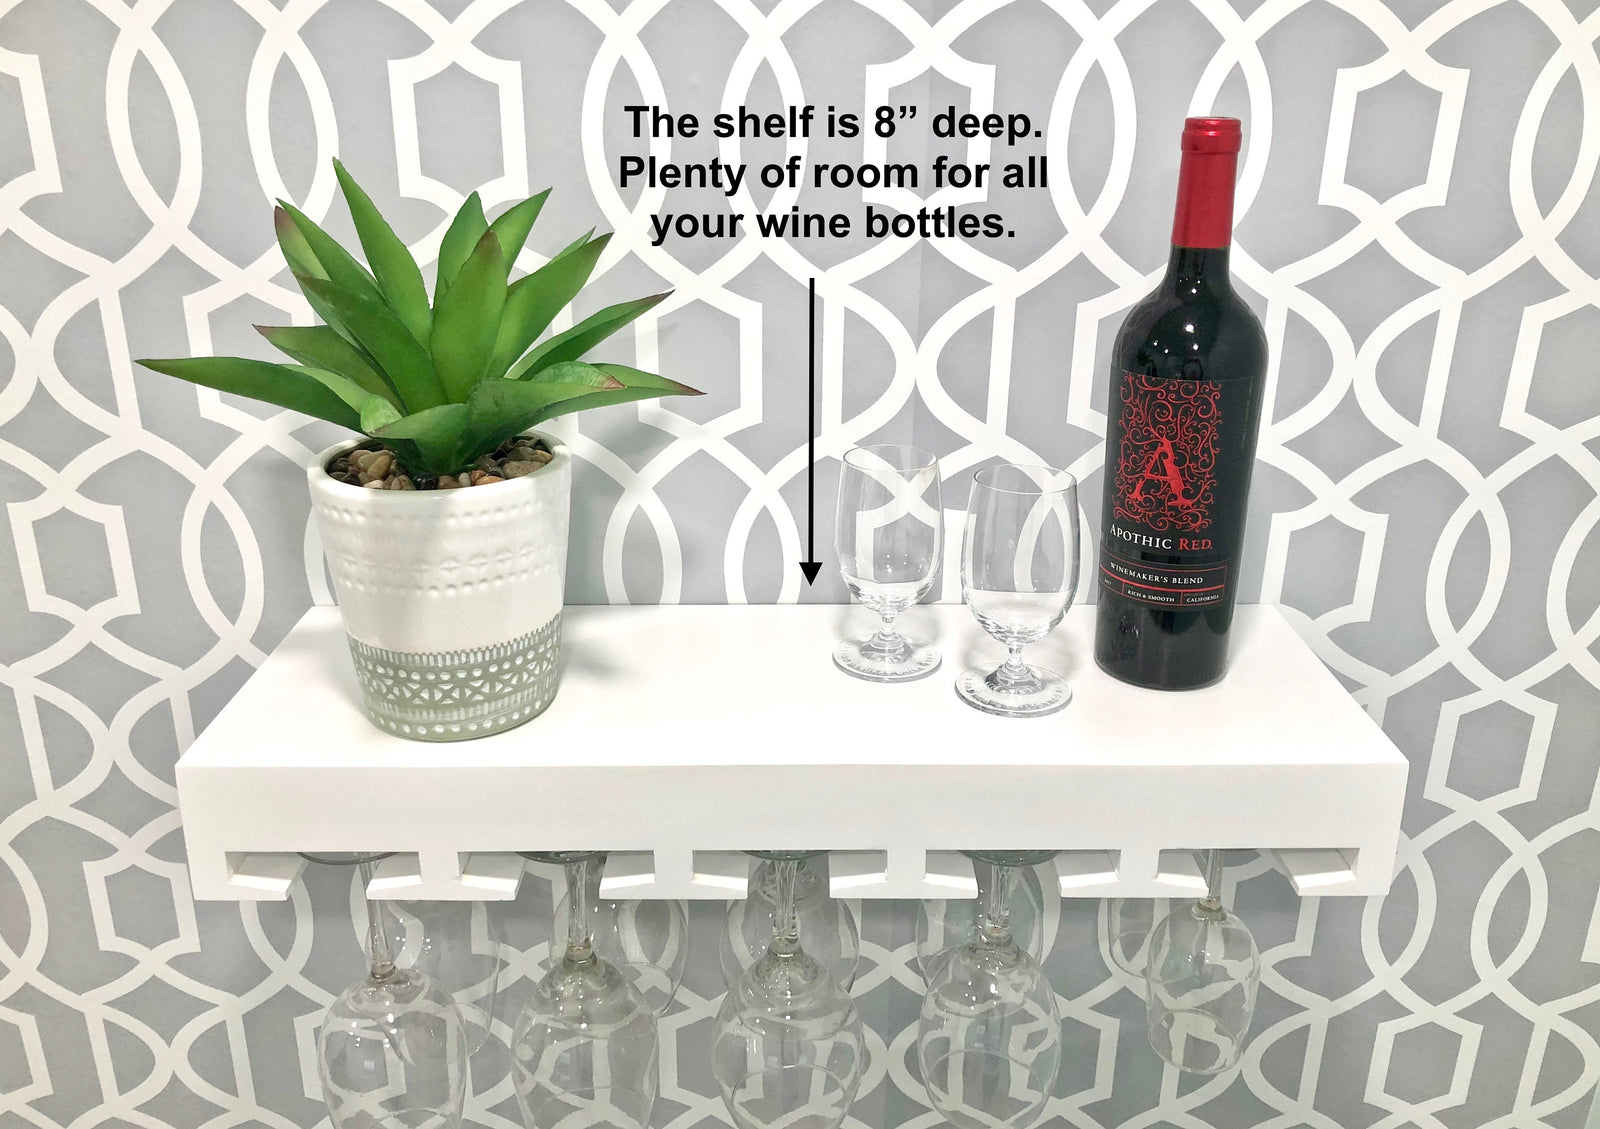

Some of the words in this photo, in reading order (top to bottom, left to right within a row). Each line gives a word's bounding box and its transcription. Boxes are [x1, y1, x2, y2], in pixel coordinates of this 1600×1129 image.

[1128, 435, 1194, 507] A
[1110, 523, 1172, 550] APOTHIC
[1110, 562, 1169, 583] WINEMAKER'S
[1172, 576, 1204, 585] BLEND
[1127, 589, 1142, 598] RICH
[1147, 594, 1175, 603] SMOOTH
[1186, 593, 1220, 603] CALIFORNIA
